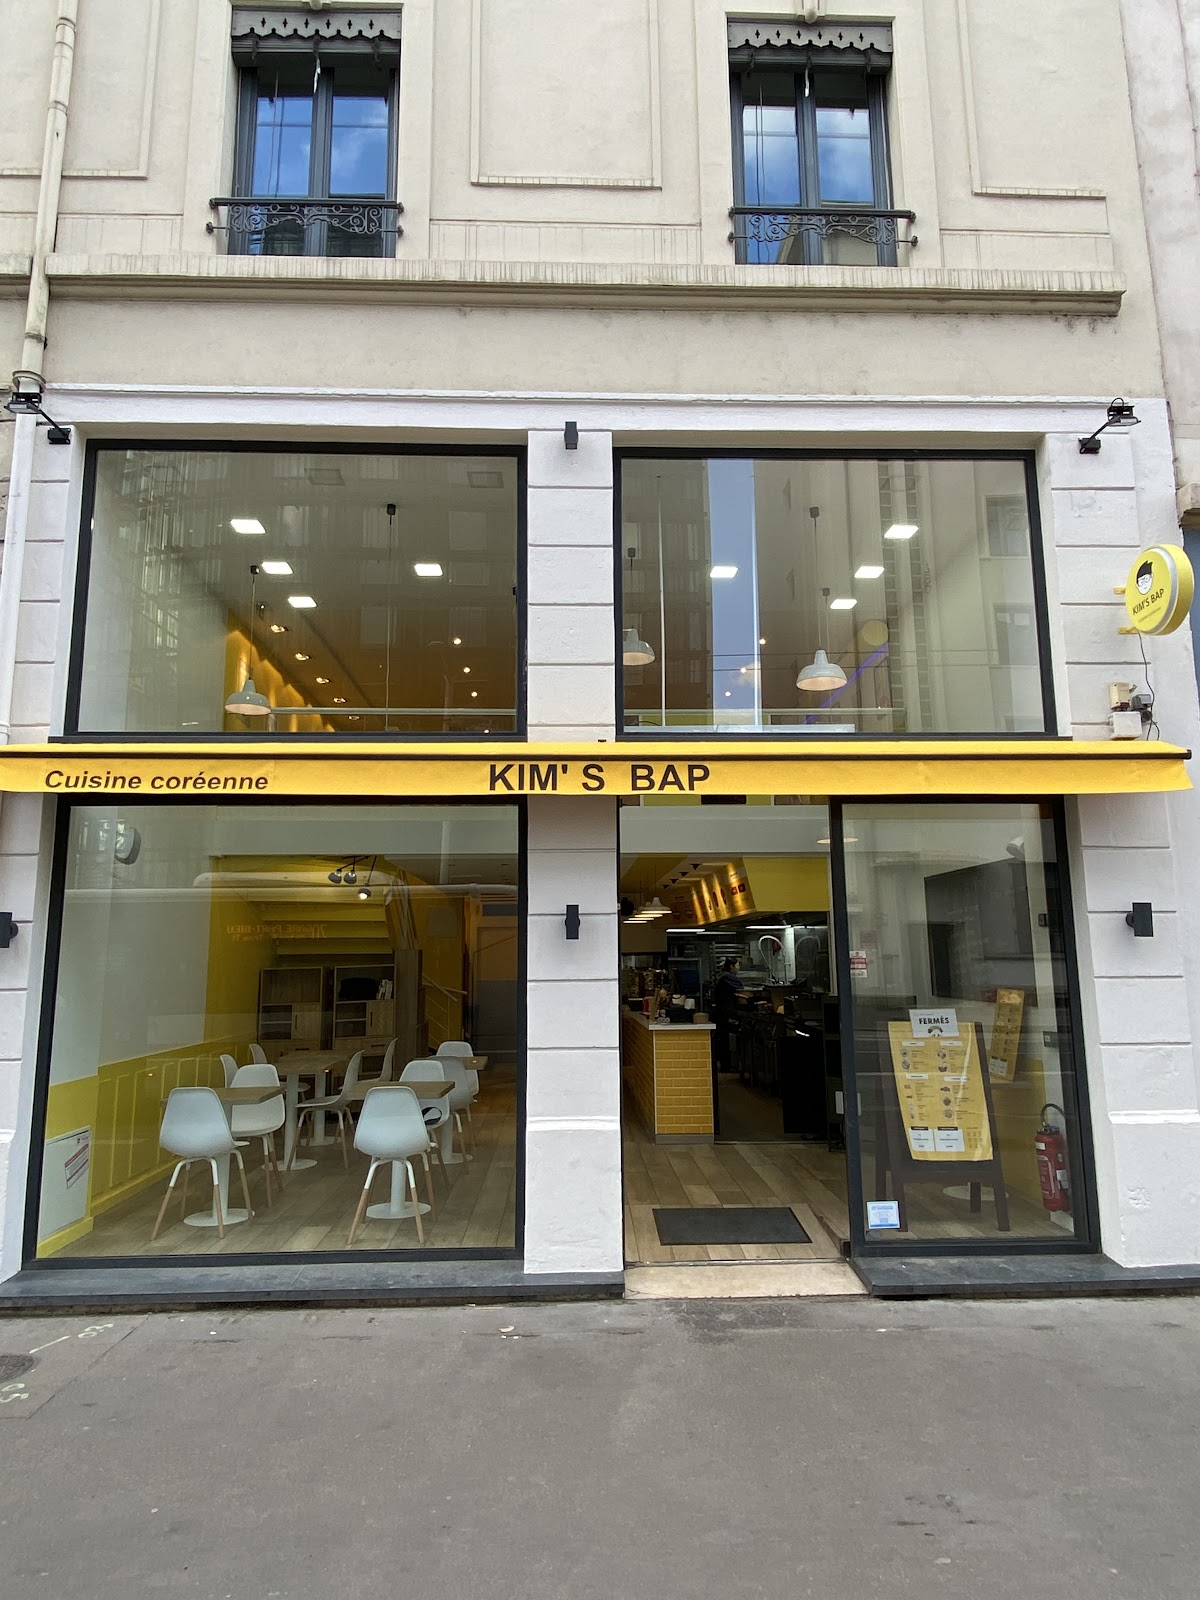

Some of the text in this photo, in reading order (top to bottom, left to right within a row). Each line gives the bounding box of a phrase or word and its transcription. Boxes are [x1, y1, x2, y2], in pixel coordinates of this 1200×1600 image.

[1132, 597, 1150, 615] KIM'S
[1150, 588, 1164, 604] BAP
[45, 770, 269, 790] Cuisine coréenne
[631, 764, 710, 791] BAP
[918, 1015, 950, 1025] FERMÉS
